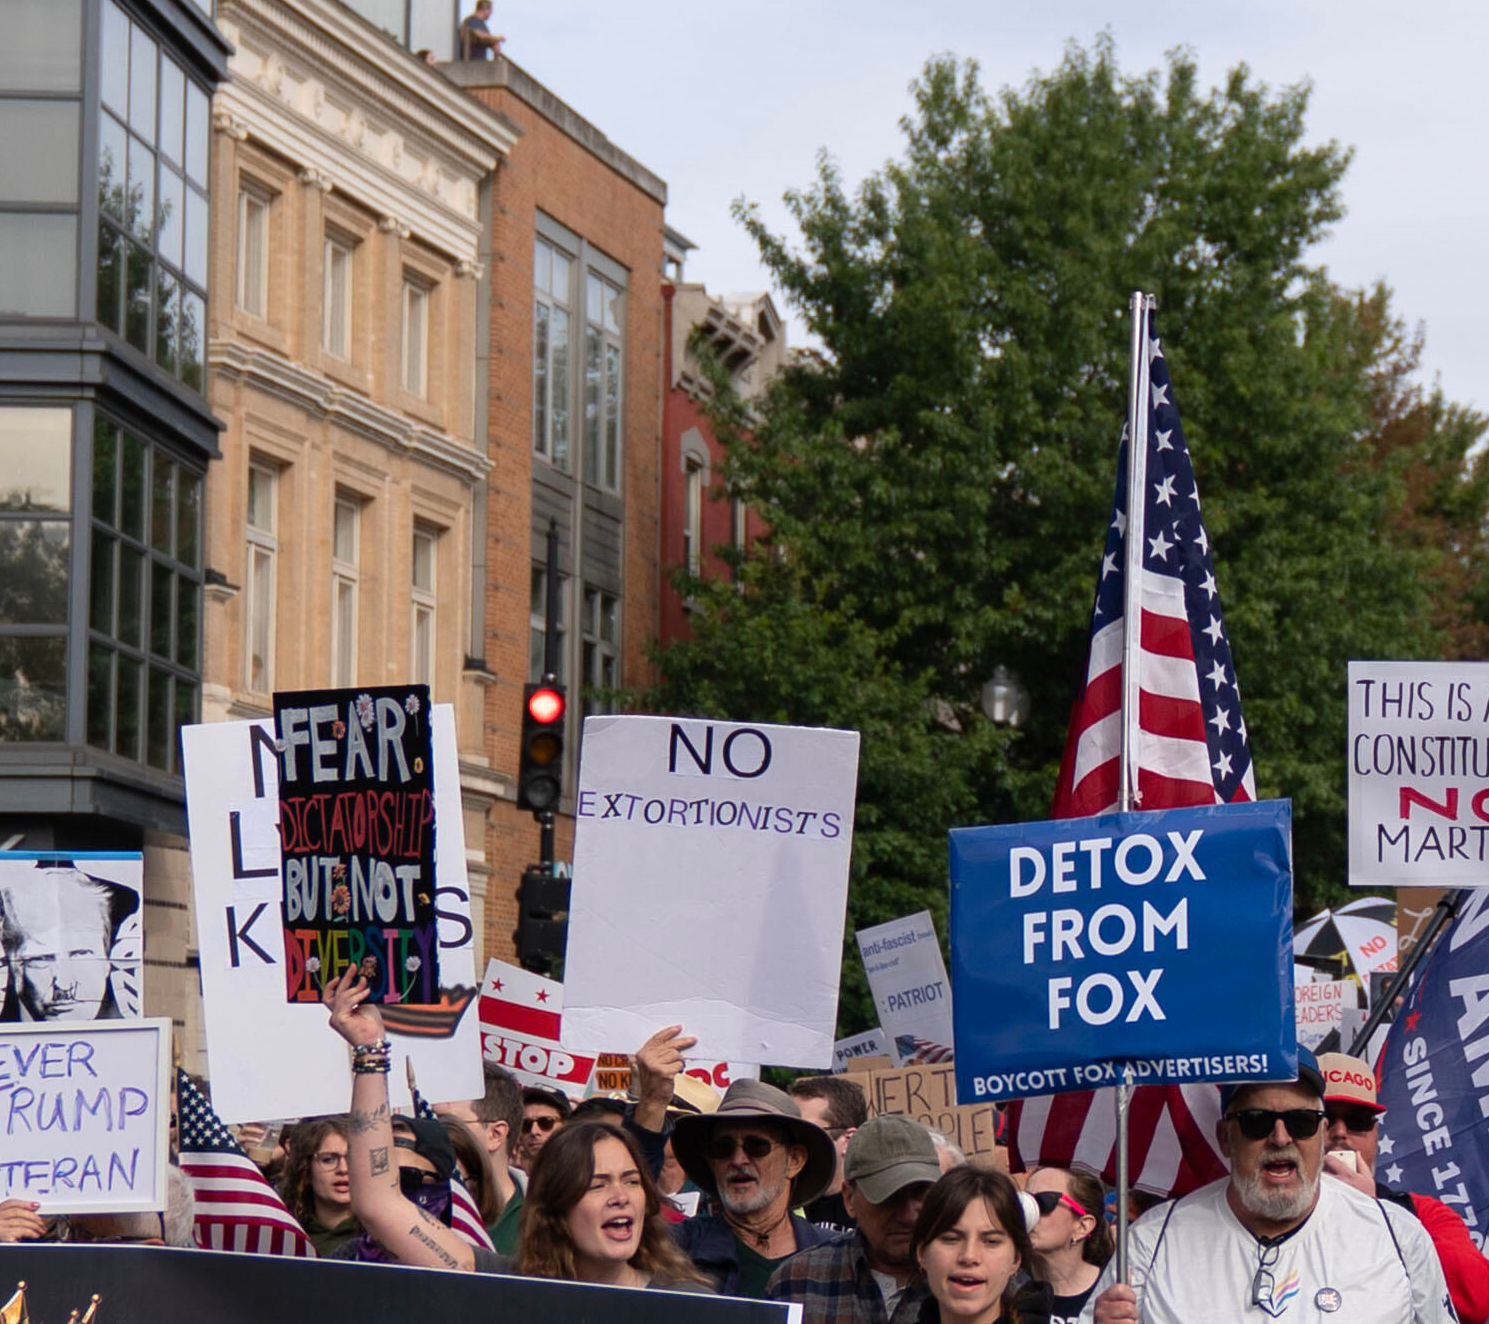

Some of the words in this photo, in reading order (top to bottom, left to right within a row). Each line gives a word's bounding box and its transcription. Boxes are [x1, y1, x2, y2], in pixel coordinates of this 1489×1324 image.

[1355, 679, 1435, 722] THIS
[1446, 681, 1473, 722] IS
[280, 696, 412, 783] FEAR
[667, 722, 773, 779] NO
[279, 789, 433, 857] DICTATORSHIP
[578, 789, 842, 839] EXTORTIONISTS
[285, 855, 340, 923] BUT
[350, 855, 422, 923] NOT
[1010, 829, 1207, 898] DETOX
[862, 929, 917, 958] anti-fascist
[1023, 897, 1189, 964] FROM
[1359, 935, 1387, 959] NO
[284, 926, 434, 1005] DIVERSITY
[1048, 968, 1166, 1030] FOX
[483, 1035, 575, 1079] STOP
[836, 1040, 879, 1062] POWER
[973, 1066, 1068, 1096] BOYCOTT
[1074, 1061, 1117, 1085] FOX
[1124, 1054, 1269, 1081] ADVERTISERS!
[1402, 1036, 1453, 1157] SINCE
